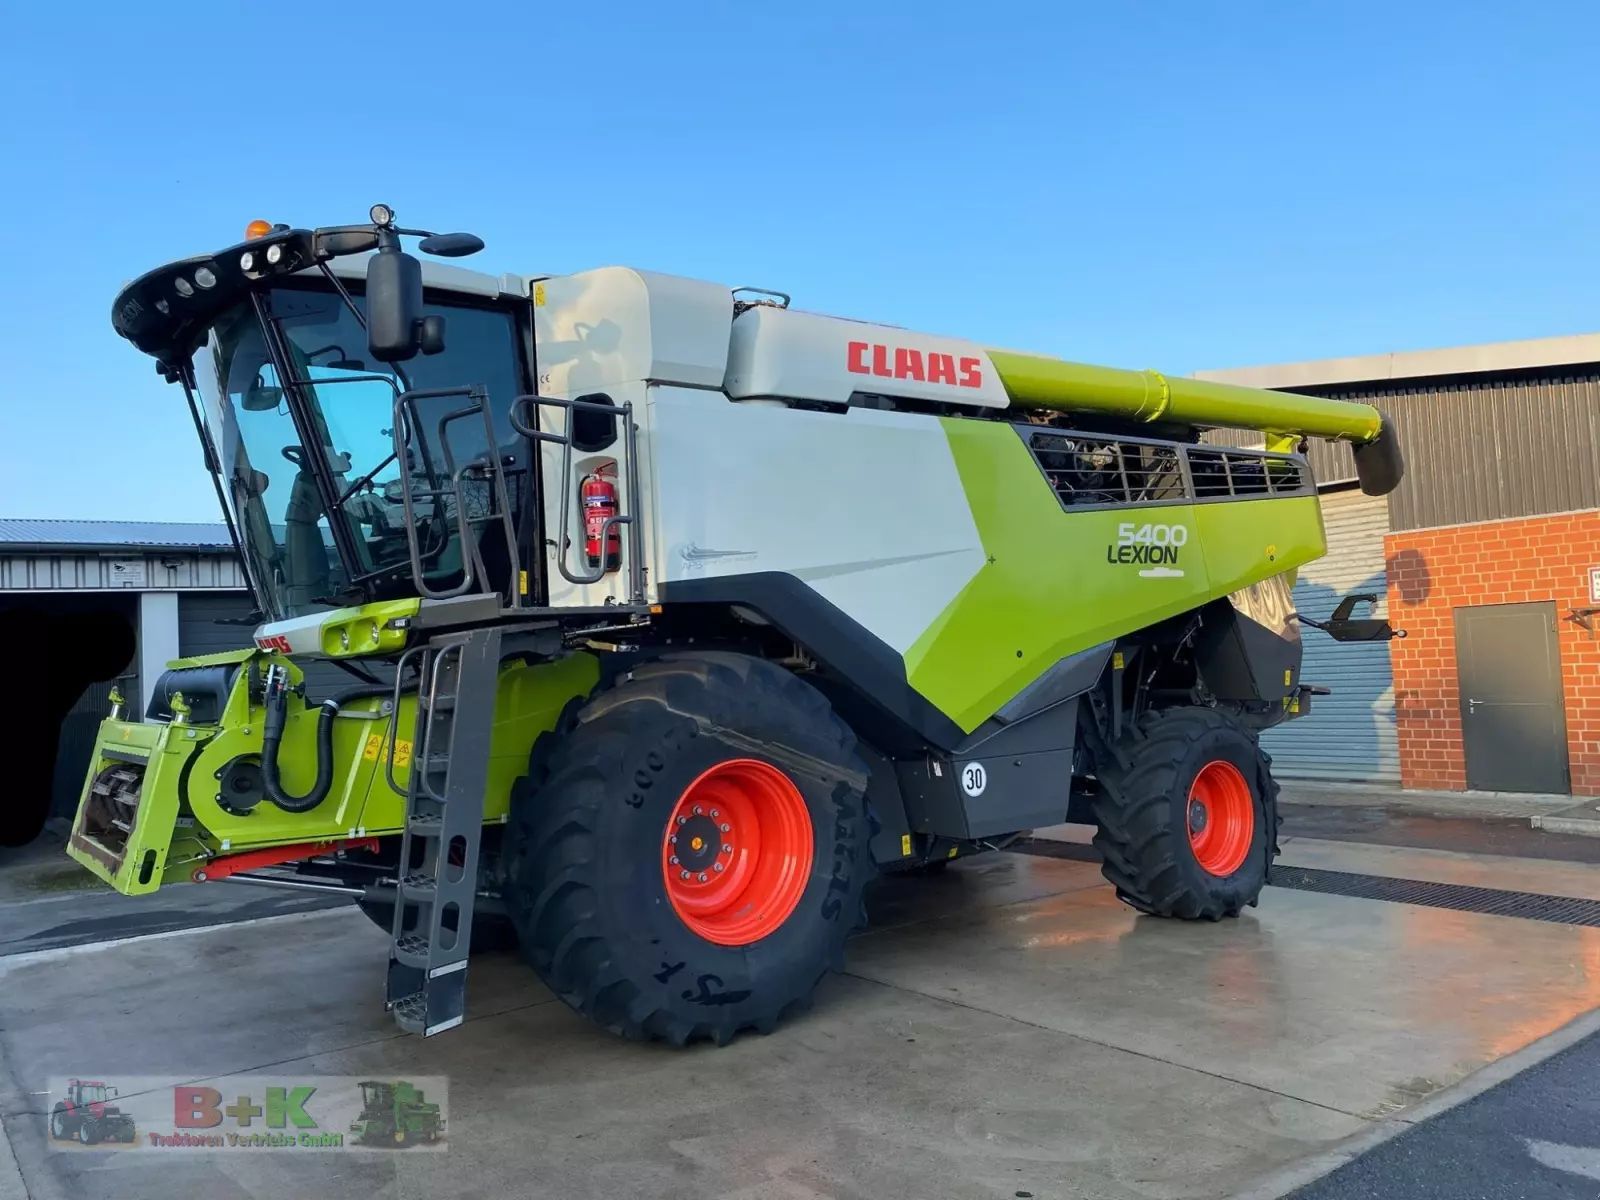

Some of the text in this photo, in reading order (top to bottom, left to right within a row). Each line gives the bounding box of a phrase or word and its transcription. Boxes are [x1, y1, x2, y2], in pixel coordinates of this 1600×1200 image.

[848, 341, 982, 389] CLAAS
[1118, 523, 1188, 547] 5400
[1107, 544, 1179, 564] LEXION
[966, 768, 982, 790] 30
